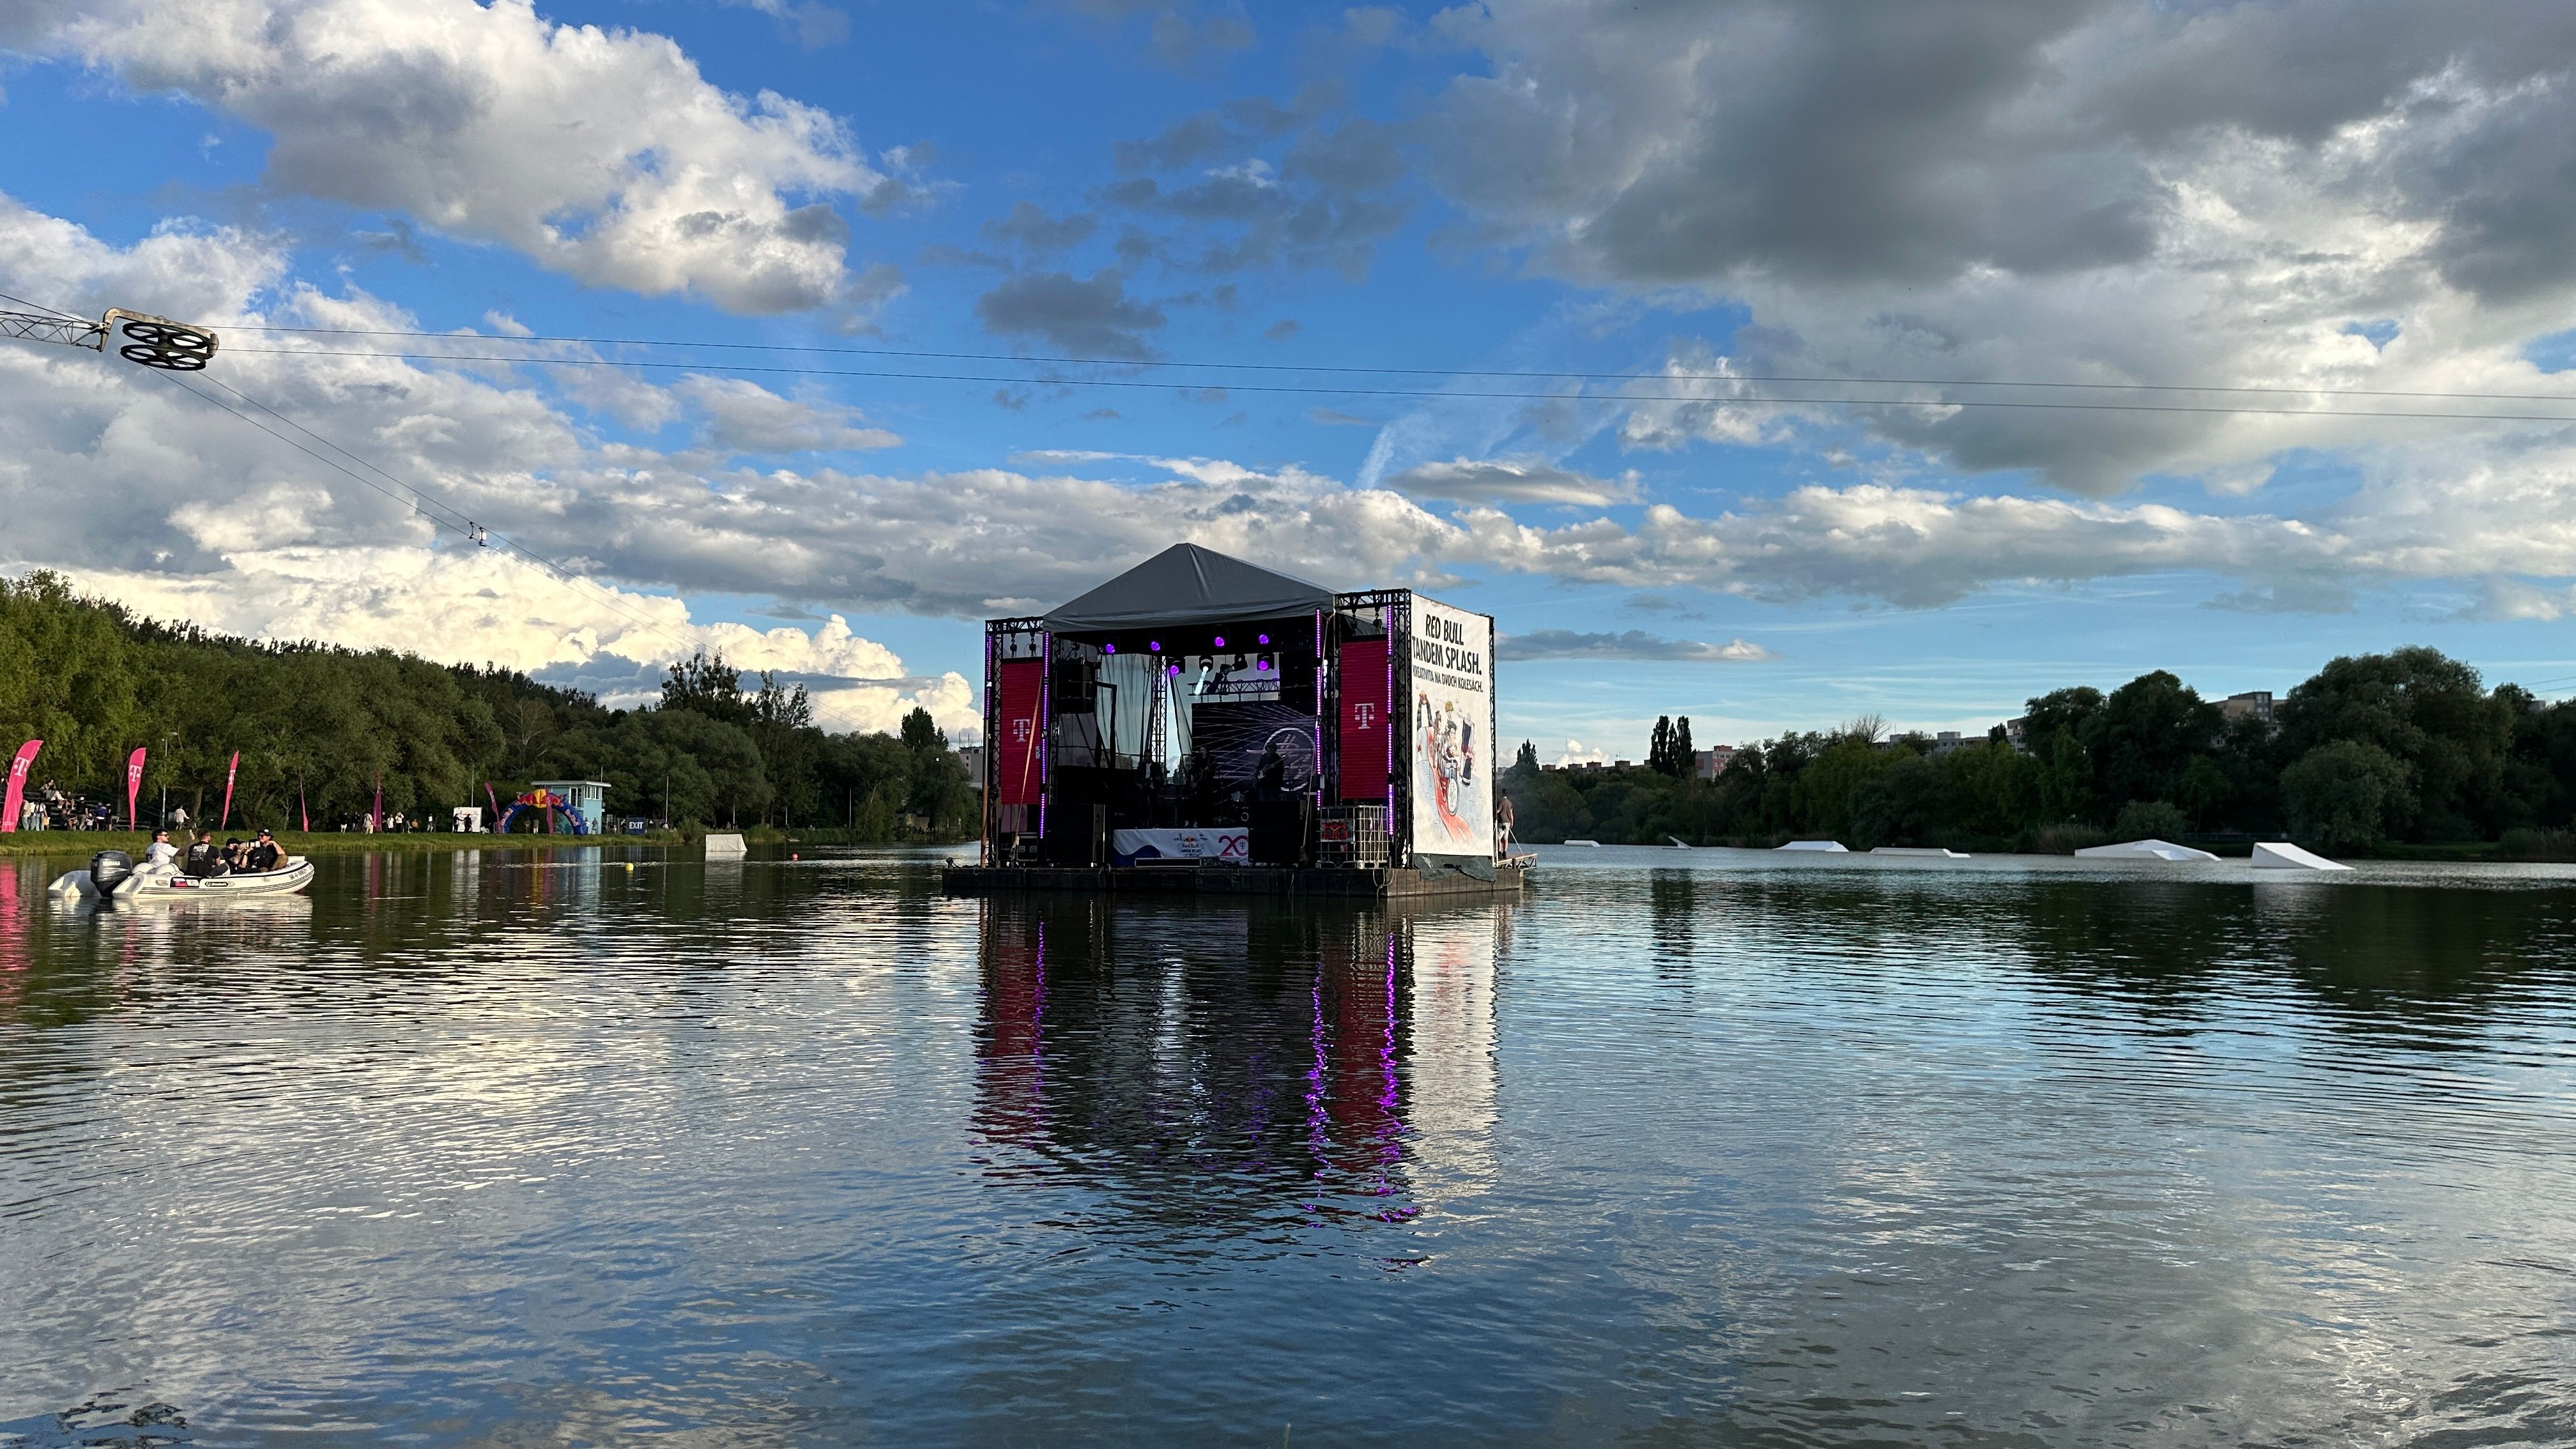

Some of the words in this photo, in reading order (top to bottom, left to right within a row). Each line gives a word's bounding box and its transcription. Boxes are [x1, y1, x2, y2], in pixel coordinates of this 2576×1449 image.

[1426, 614, 1441, 639] RED
[1444, 620, 1464, 645] BULL
[1412, 636, 1444, 667] TANDEM
[1445, 647, 1482, 675] SPLASH.
[1434, 671, 1441, 684] NA
[1442, 673, 1457, 687] DVOCH
[1354, 703, 1374, 729] T
[1013, 719, 1030, 742] T
[14, 756, 30, 777] T
[130, 765, 142, 782] T
